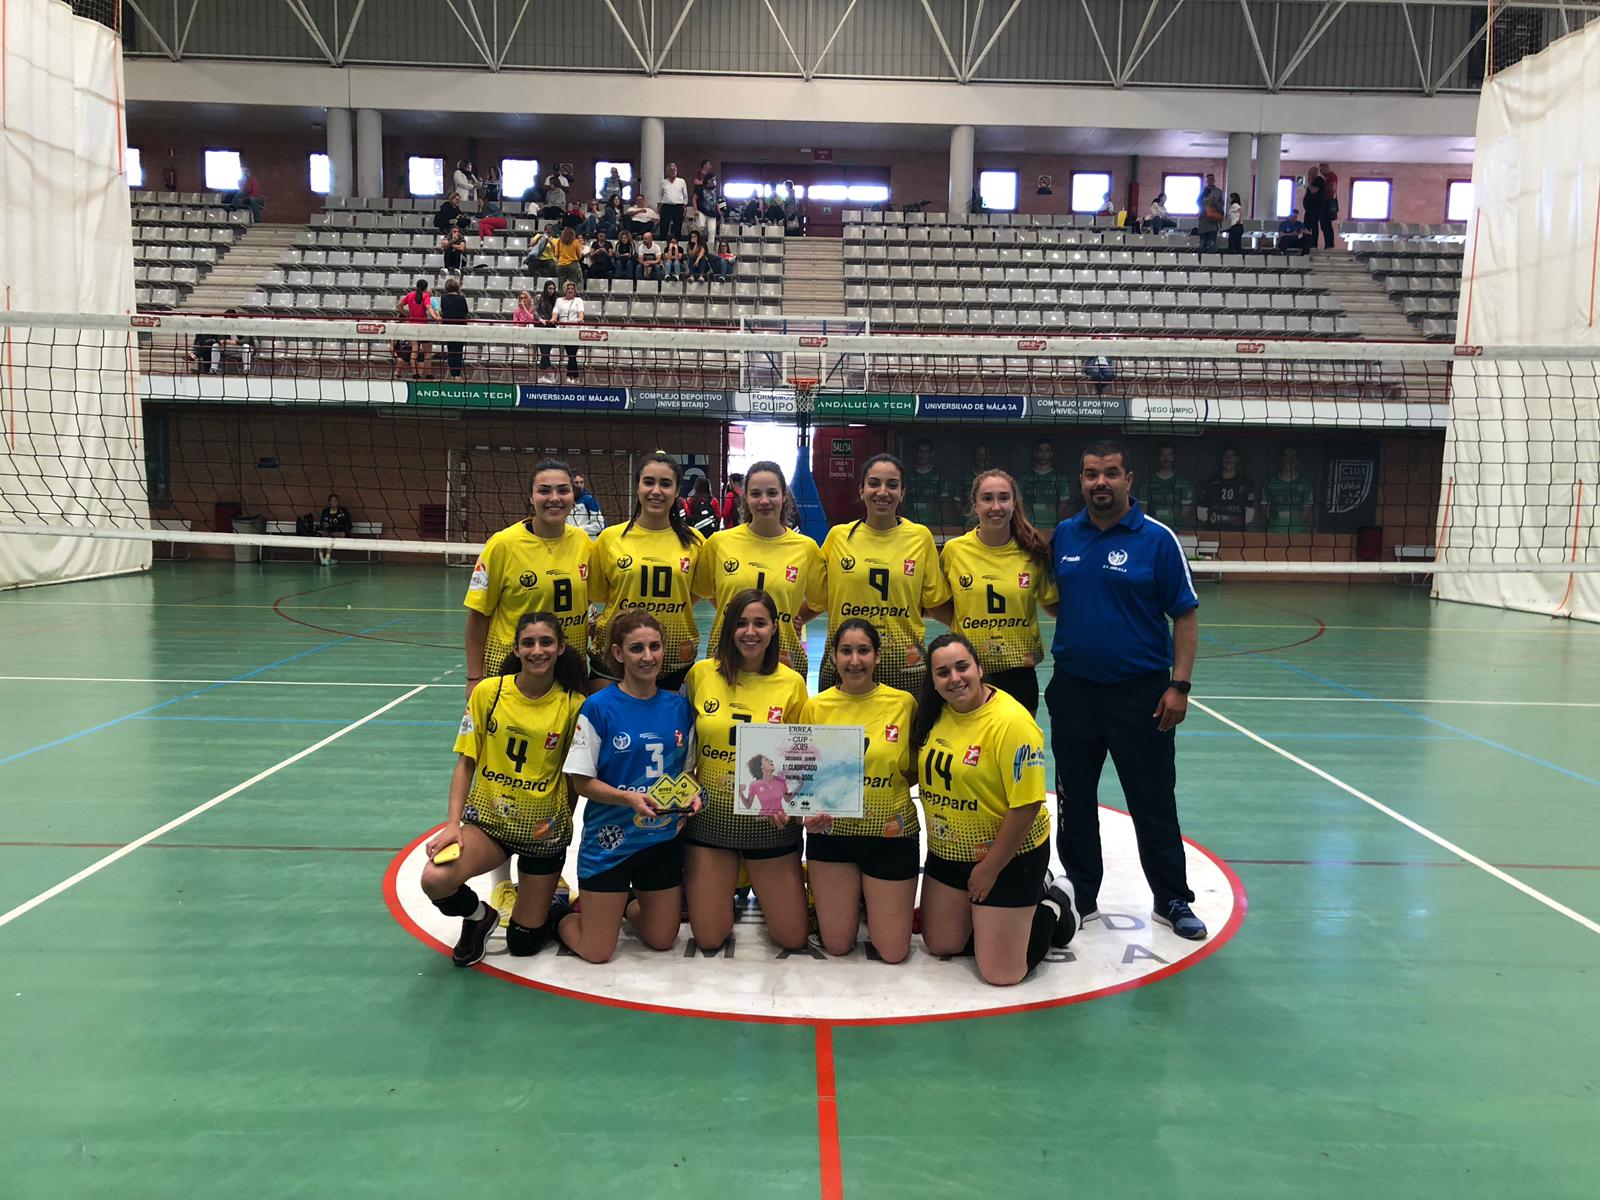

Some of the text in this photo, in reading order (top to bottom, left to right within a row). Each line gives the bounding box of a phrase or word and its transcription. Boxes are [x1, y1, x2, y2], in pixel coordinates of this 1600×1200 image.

[639, 393, 722, 401] COMPLEJO DEPORTIVO
[752, 401, 794, 412] EQUIPO
[925, 402, 973, 410] UNIVERSIDAD
[974, 403, 985, 411] DE
[1077, 400, 1119, 408] EPORTIVO
[1221, 488, 1234, 500] 20
[553, 578, 572, 612] 8
[640, 565, 672, 597] 10
[869, 568, 889, 601] 9
[506, 736, 528, 773] 4
[645, 743, 664, 778] 3
[925, 748, 954, 792] 14
